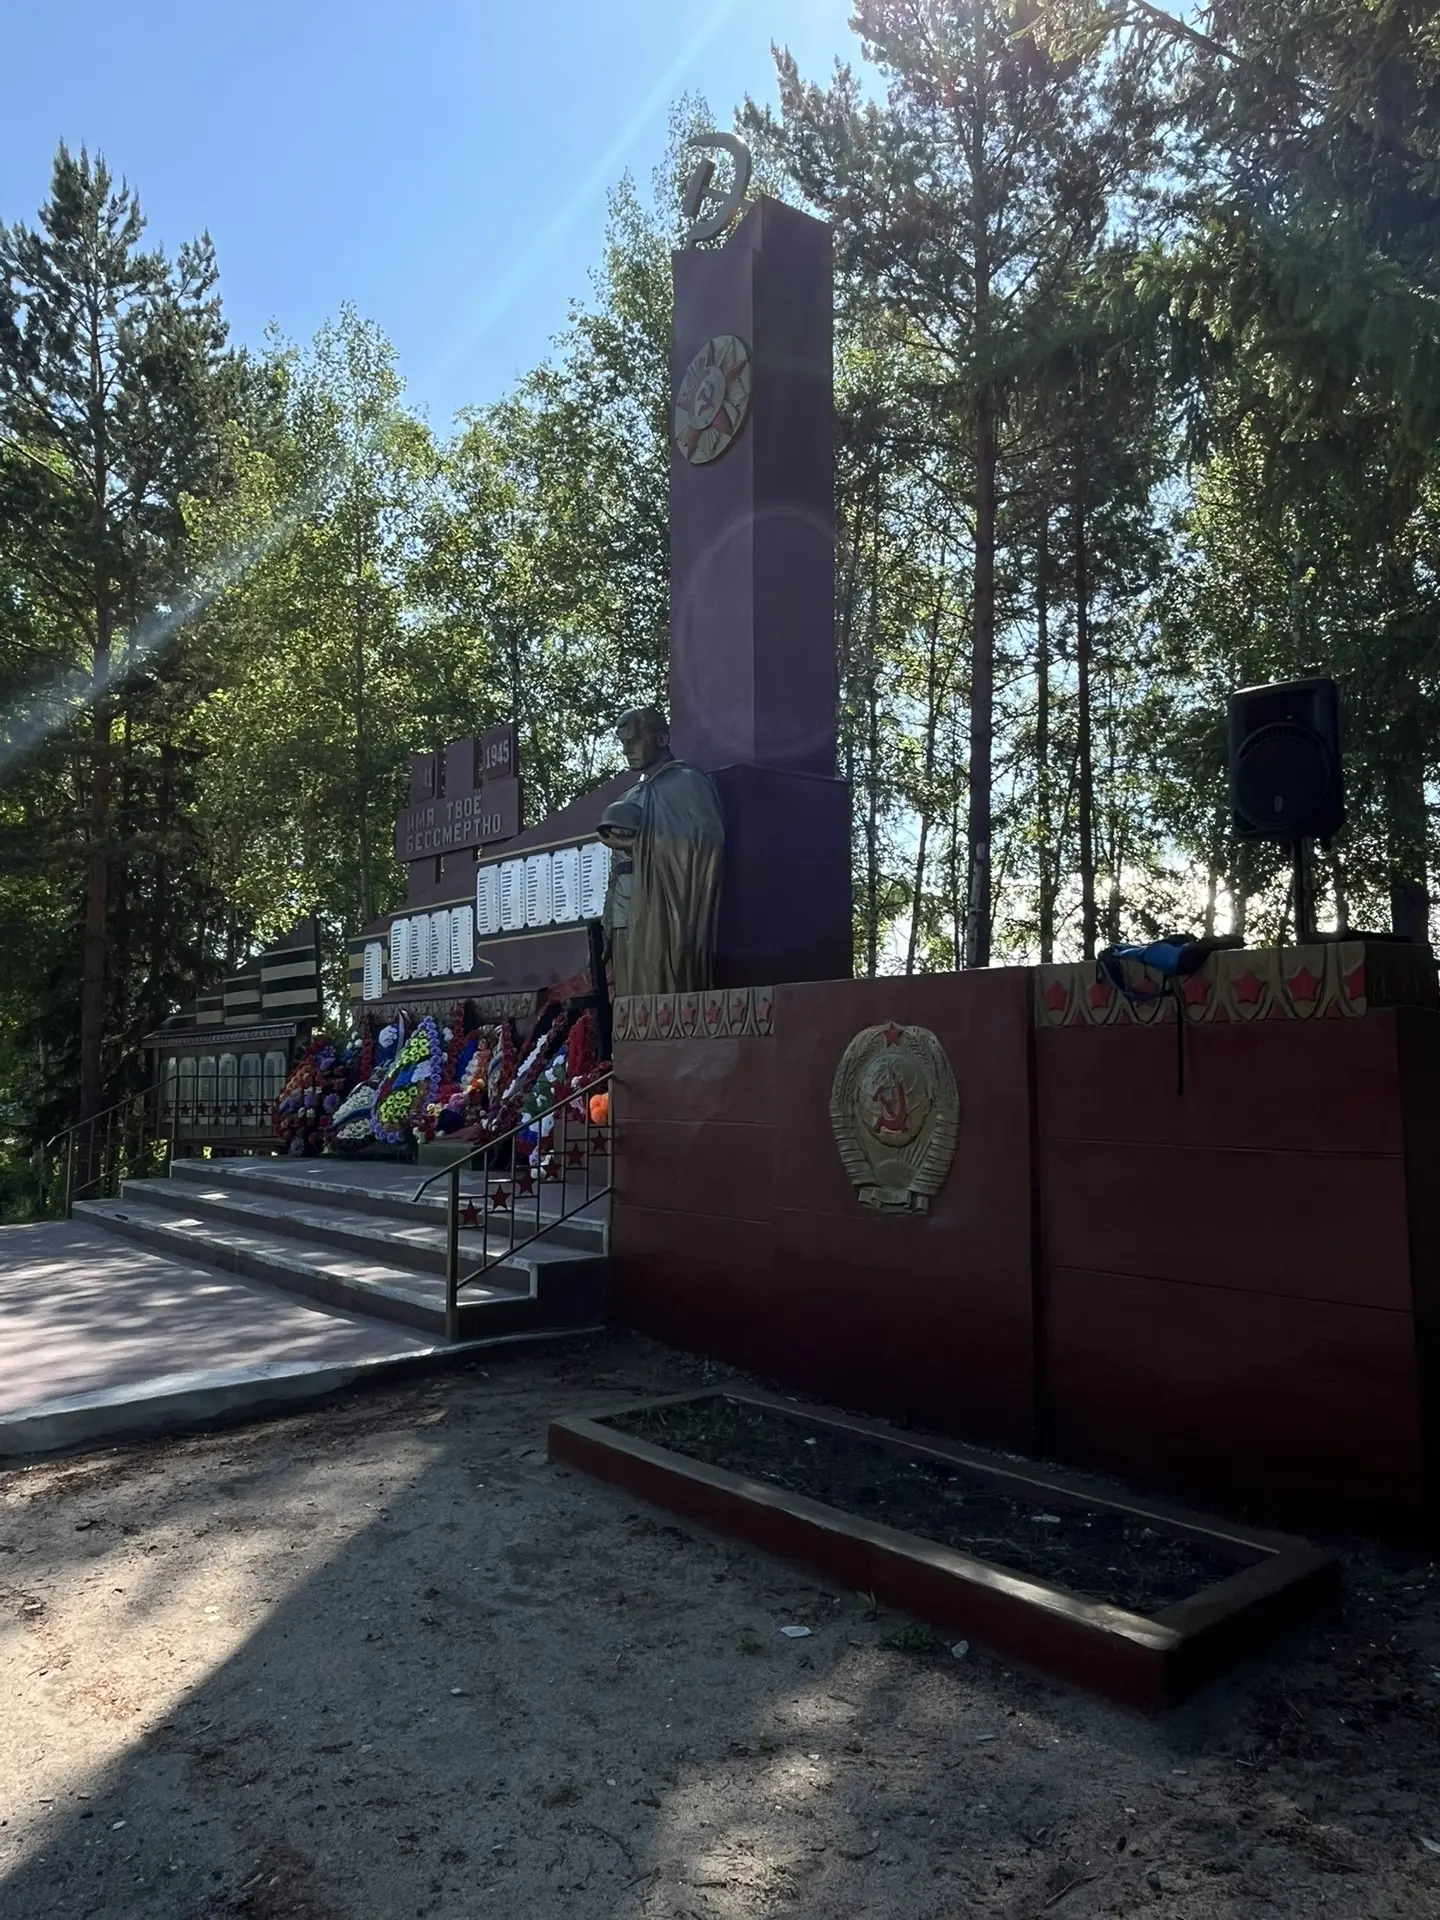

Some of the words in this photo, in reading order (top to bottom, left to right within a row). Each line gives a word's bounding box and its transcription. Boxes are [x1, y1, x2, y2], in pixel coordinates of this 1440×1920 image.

[486, 739, 509, 769] 1945
[406, 807, 434, 832] ИМЯ
[406, 813, 501, 853] БЕССМЕРТНО
